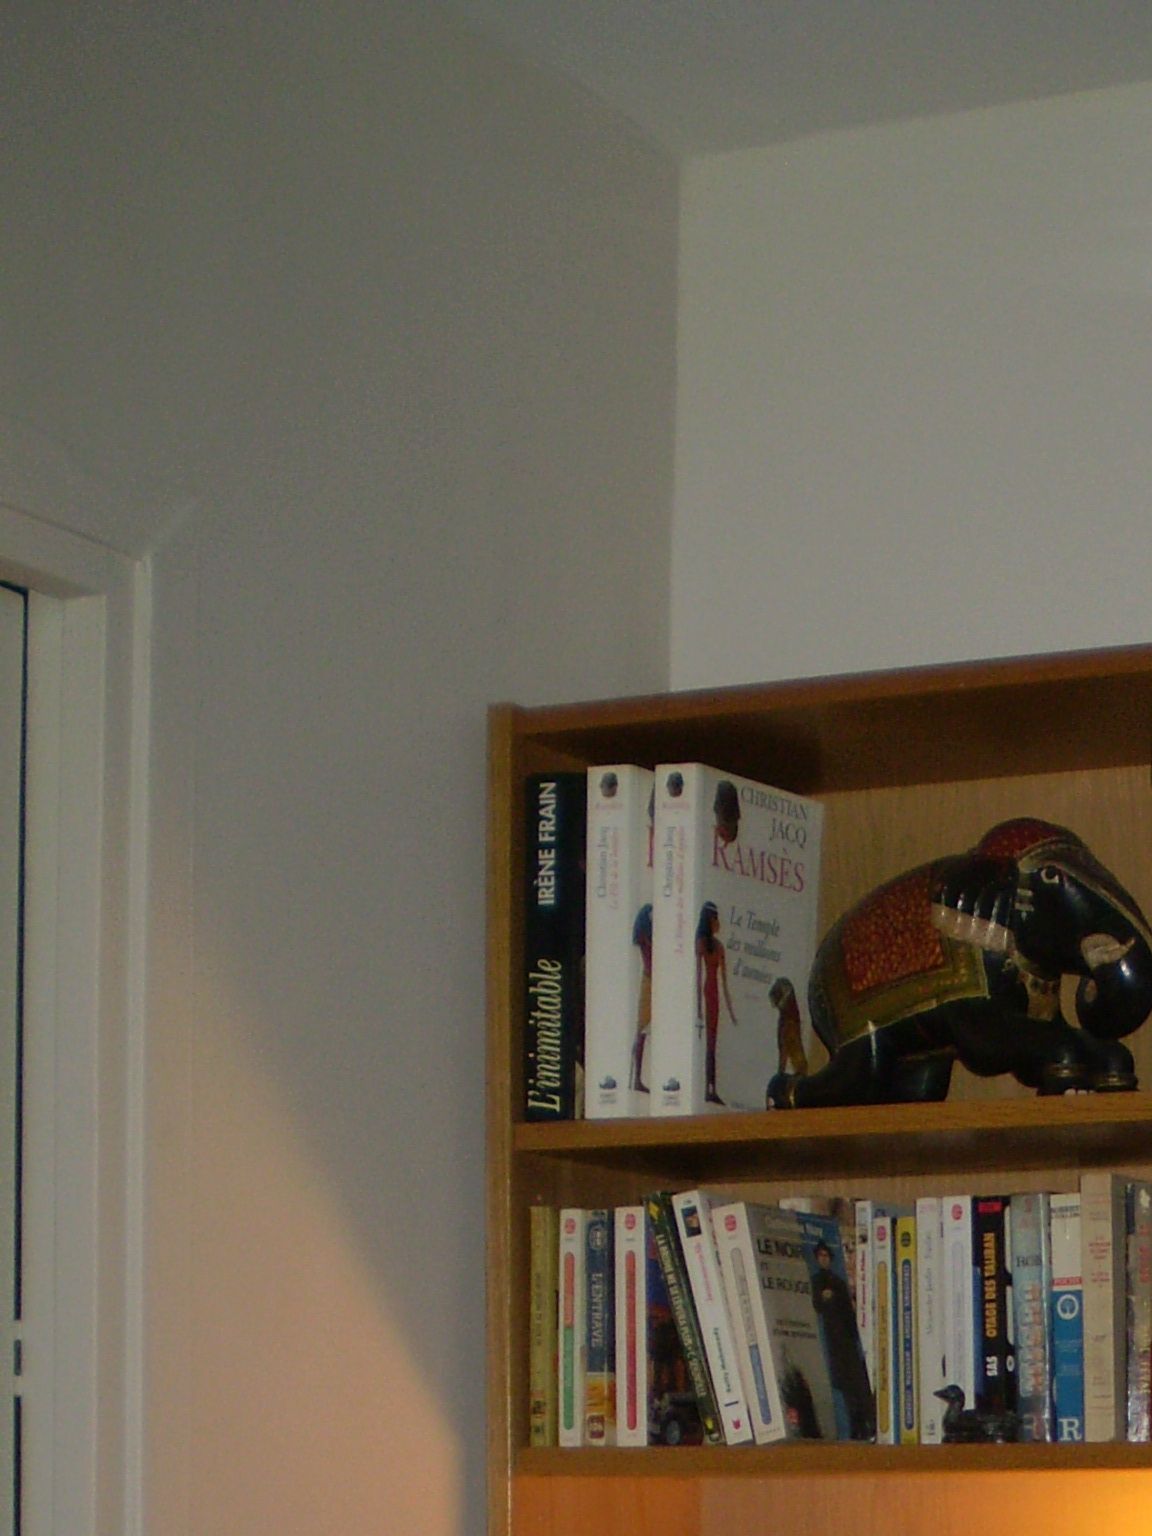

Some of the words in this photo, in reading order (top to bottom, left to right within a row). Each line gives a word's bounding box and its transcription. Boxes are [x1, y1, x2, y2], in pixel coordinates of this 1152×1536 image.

[539, 782, 558, 843] FRAIN
[740, 785, 809, 821] CHRISTIAN
[768, 816, 808, 850] JACQ
[711, 832, 806, 893] RAMSÈS
[527, 957, 563, 1113] L'inimitable
[757, 1238, 772, 1254] LE
[983, 1232, 995, 1276] TALIBAN
[984, 1279, 996, 1299] DES
[589, 1272, 604, 1348] L'ENTRAVE
[984, 1301, 997, 1337] OTAGE
[985, 1355, 998, 1376] SAS
[1058, 1417, 1083, 1441] R
